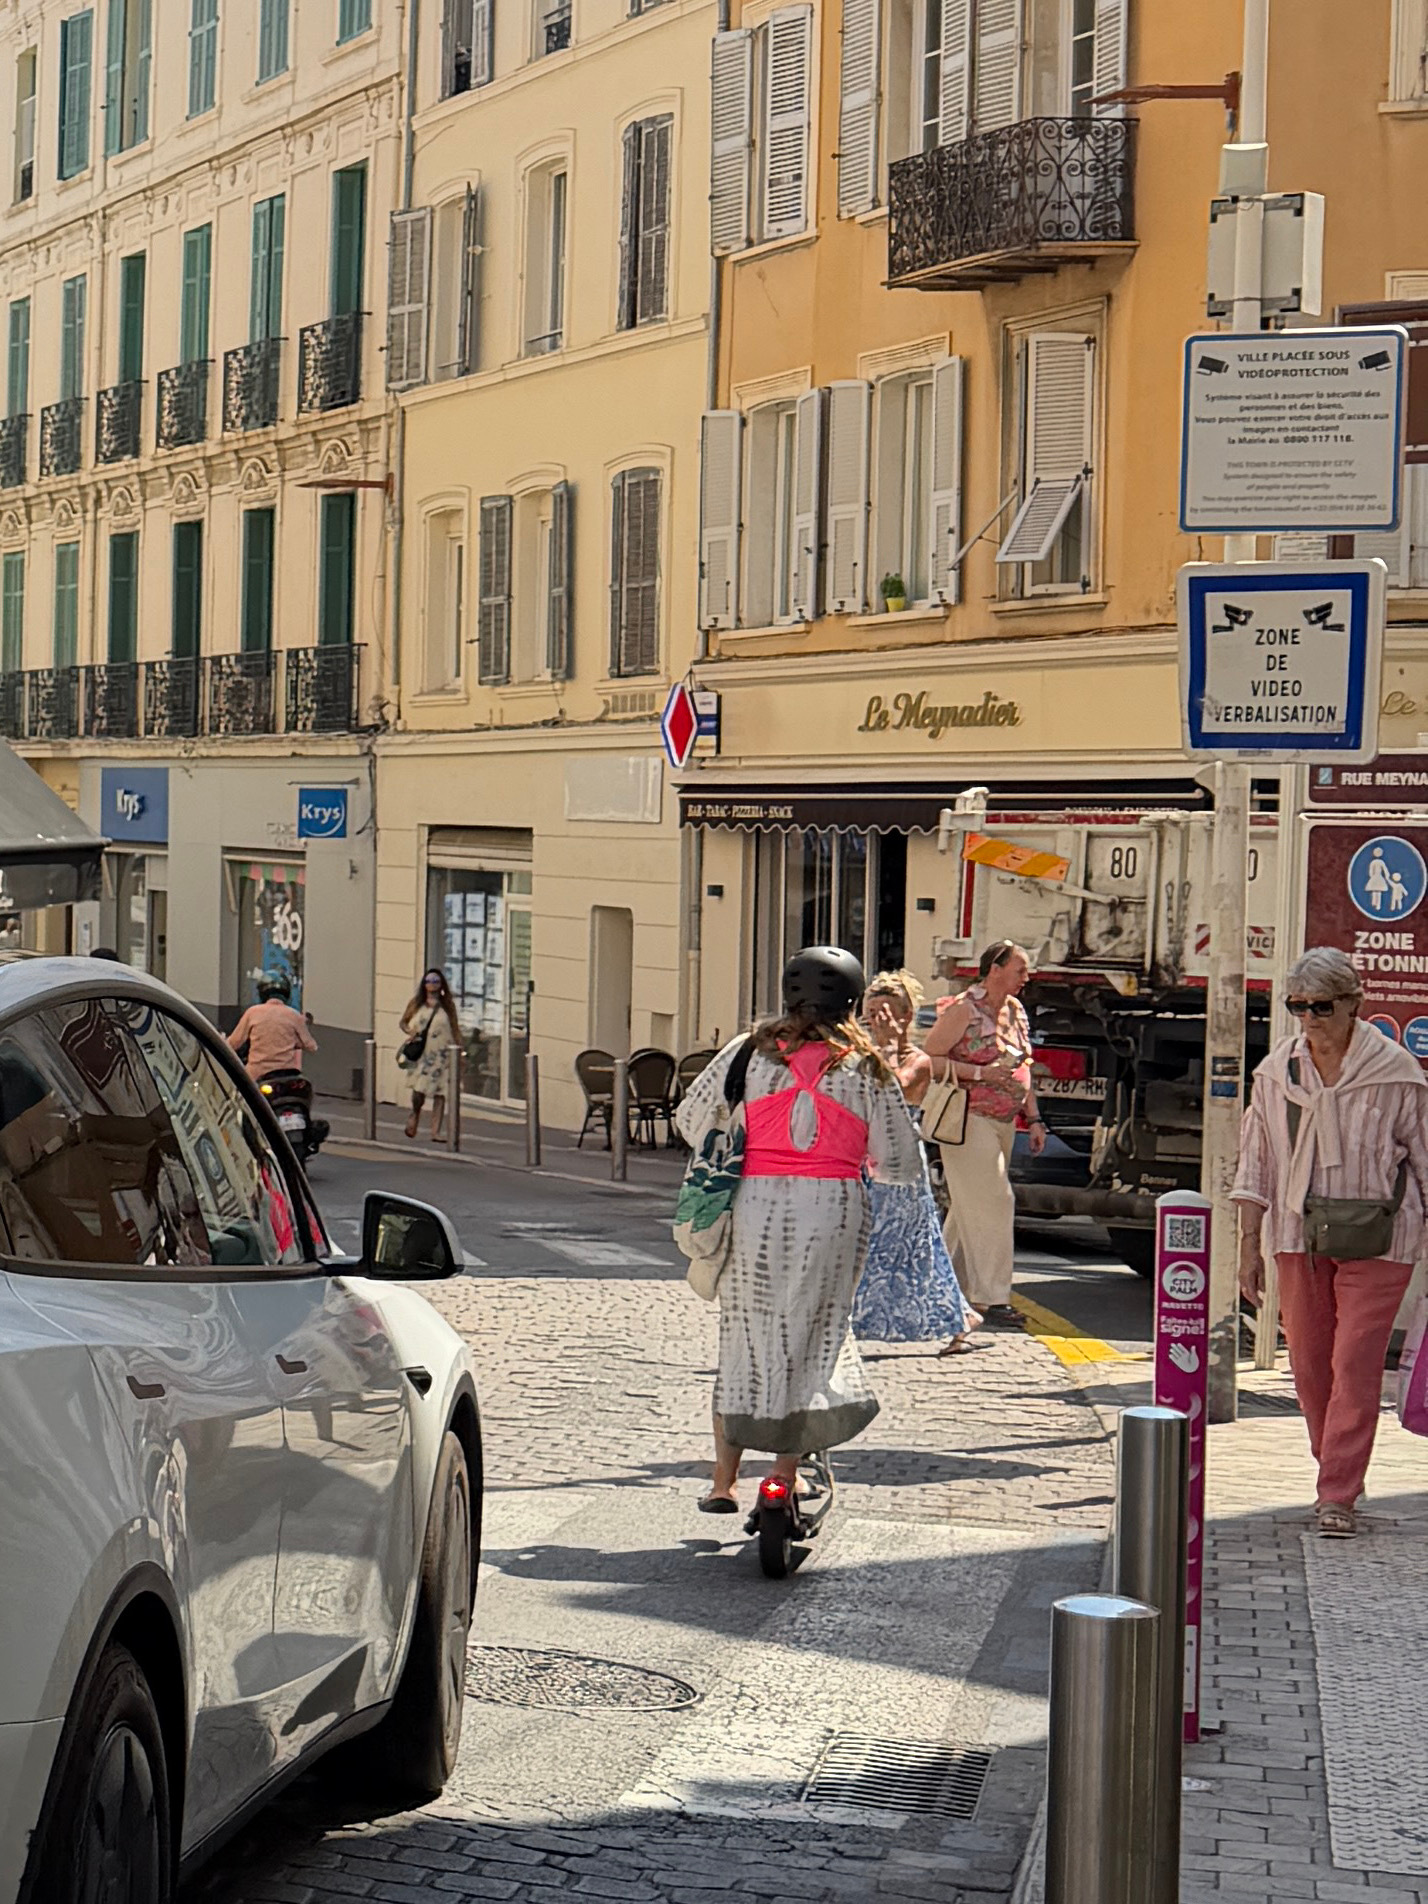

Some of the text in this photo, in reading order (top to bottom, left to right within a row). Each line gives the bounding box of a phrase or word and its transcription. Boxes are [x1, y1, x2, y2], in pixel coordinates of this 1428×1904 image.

[1237, 350, 1350, 363] VILLE PLACÉE SOUS
[1238, 366, 1349, 379] VIDÉOPROTECTION
[1255, 628, 1301, 645] ZONE
[1266, 654, 1288, 671] DE
[1251, 679, 1303, 697] VIDEO
[1383, 691, 1417, 715] Le
[857, 690, 1020, 739] Le Meynadier
[1214, 705, 1337, 723] VERBALISATION
[1341, 772, 1372, 786] RUE
[116, 789, 139, 821] Krys
[301, 804, 340, 824] Krys
[1110, 847, 1137, 878] 80
[1248, 848, 1258, 881] 0
[1354, 931, 1415, 950] ZONE
